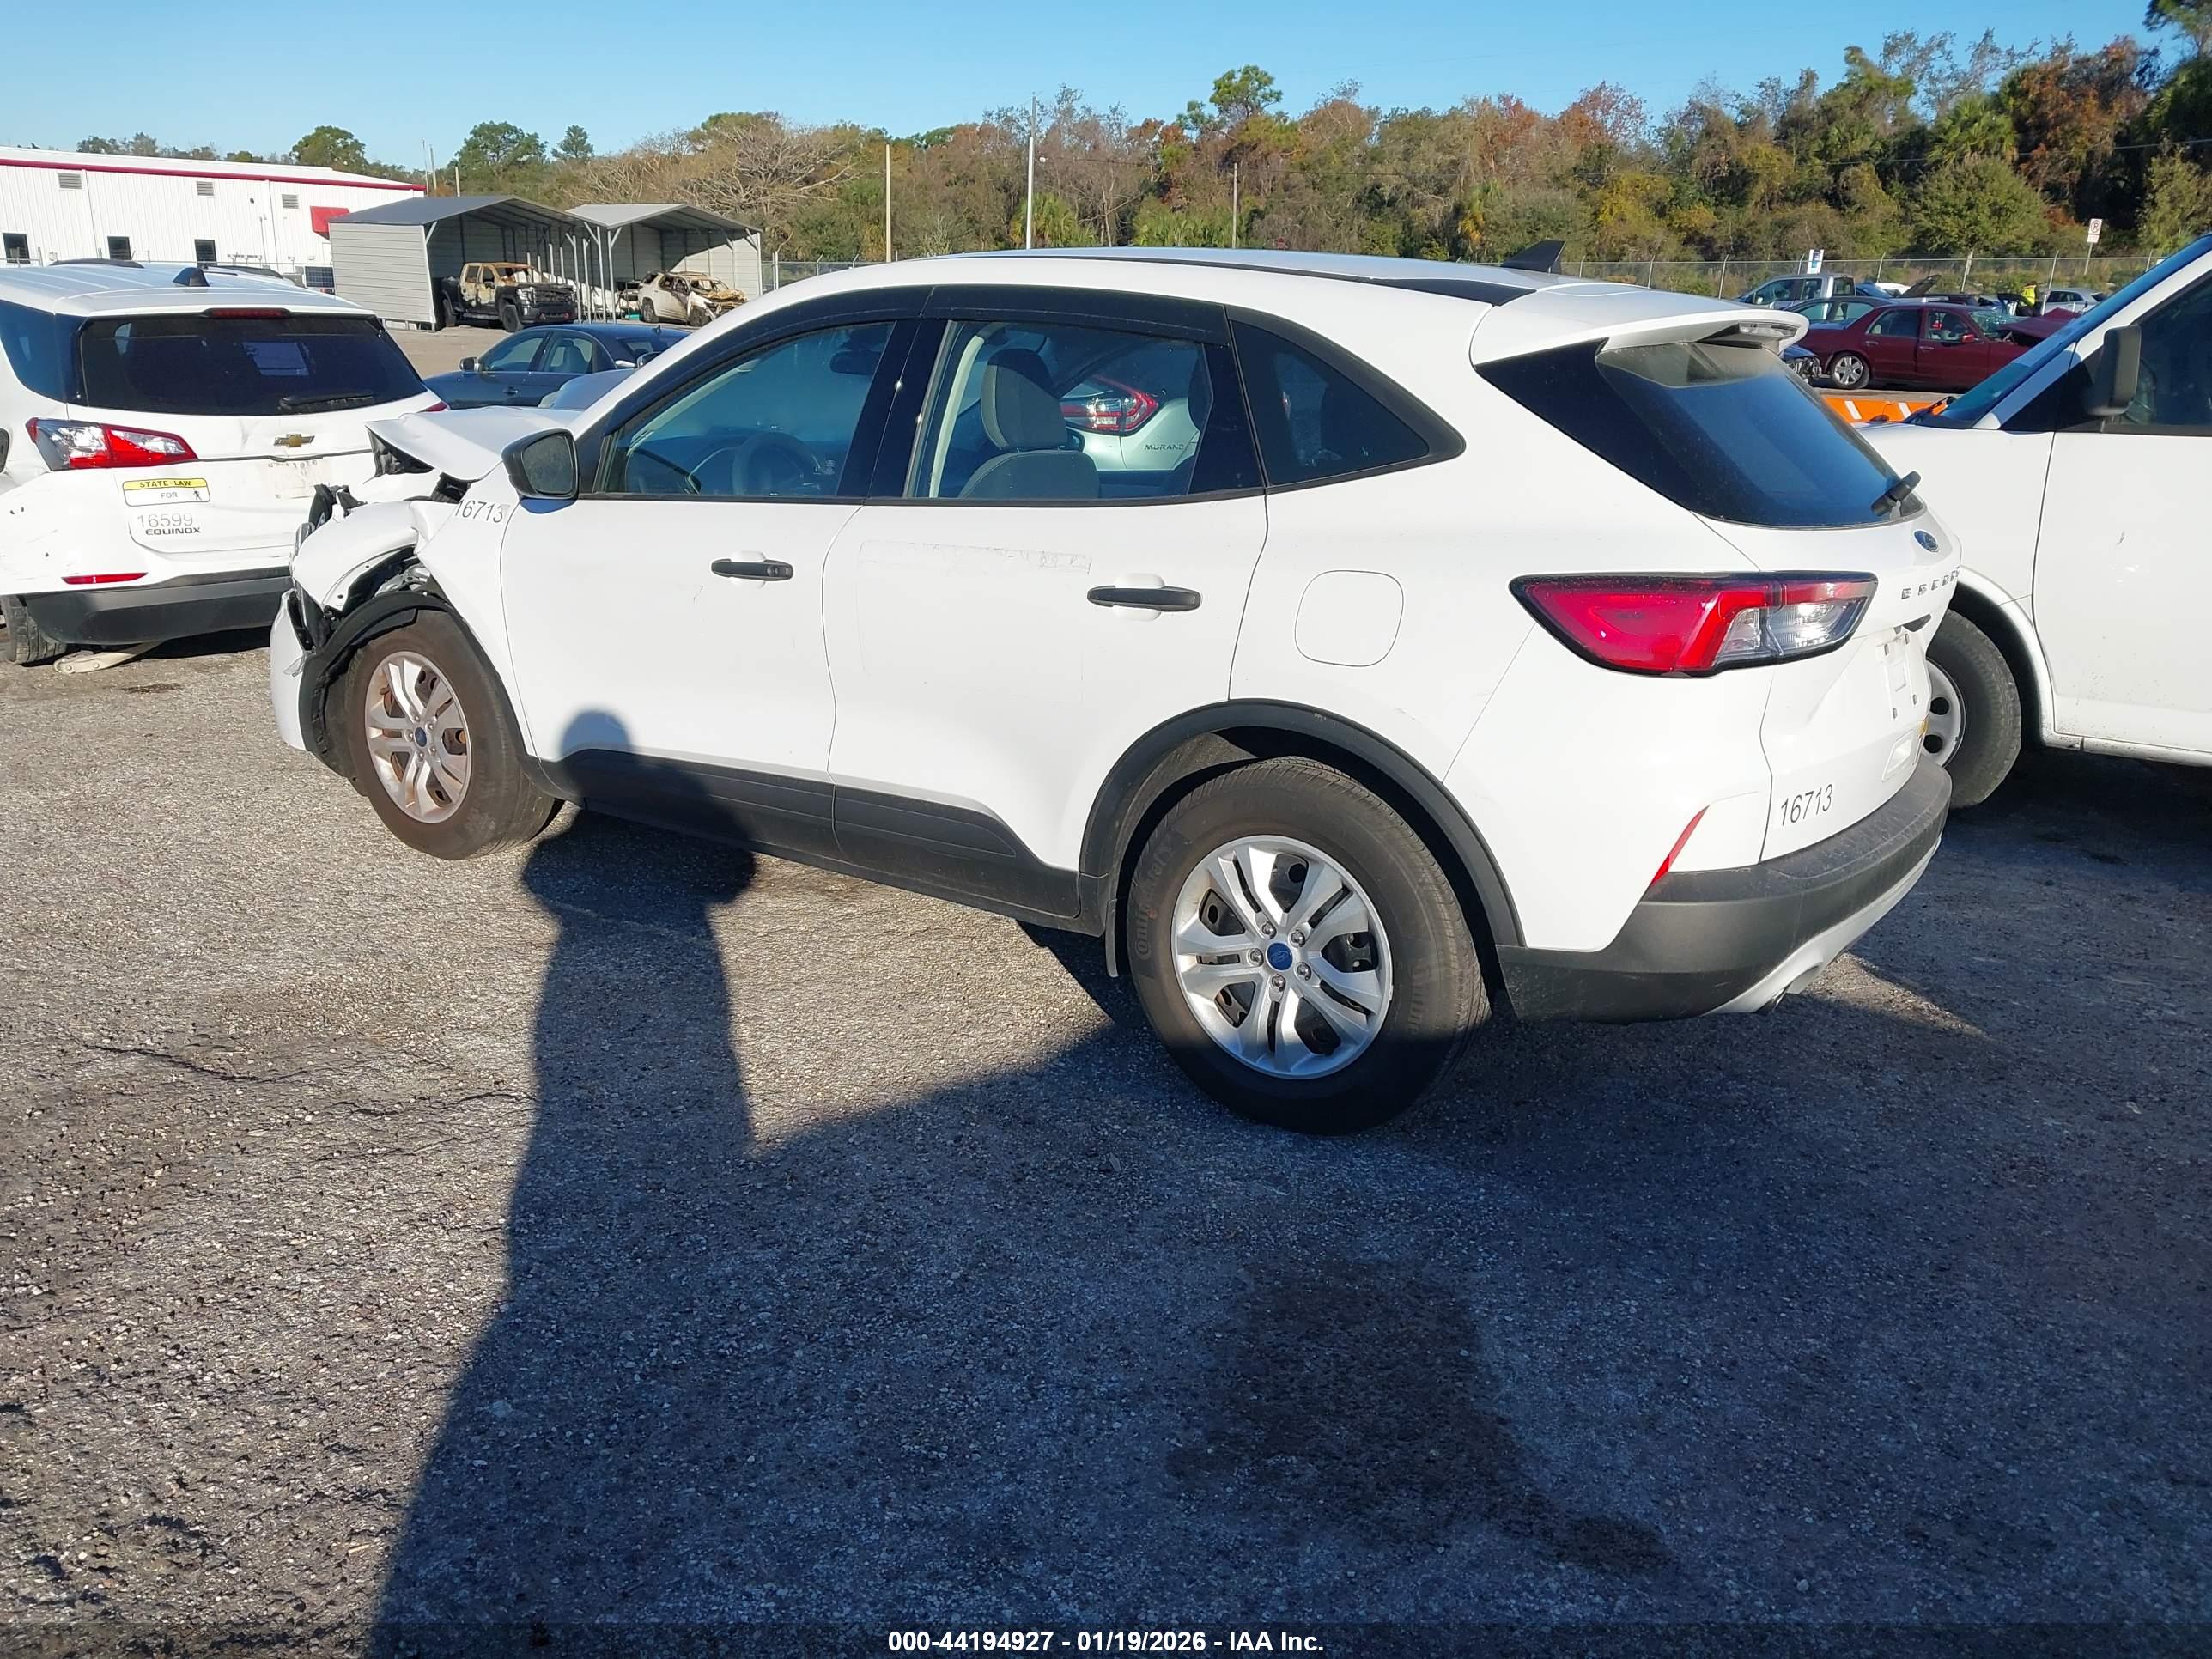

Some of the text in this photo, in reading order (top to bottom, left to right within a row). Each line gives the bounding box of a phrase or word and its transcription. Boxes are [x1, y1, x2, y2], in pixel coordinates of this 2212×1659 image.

[137, 513, 193, 528] 16599
[454, 500, 503, 523] 16713
[1781, 783, 1833, 826] 16713
